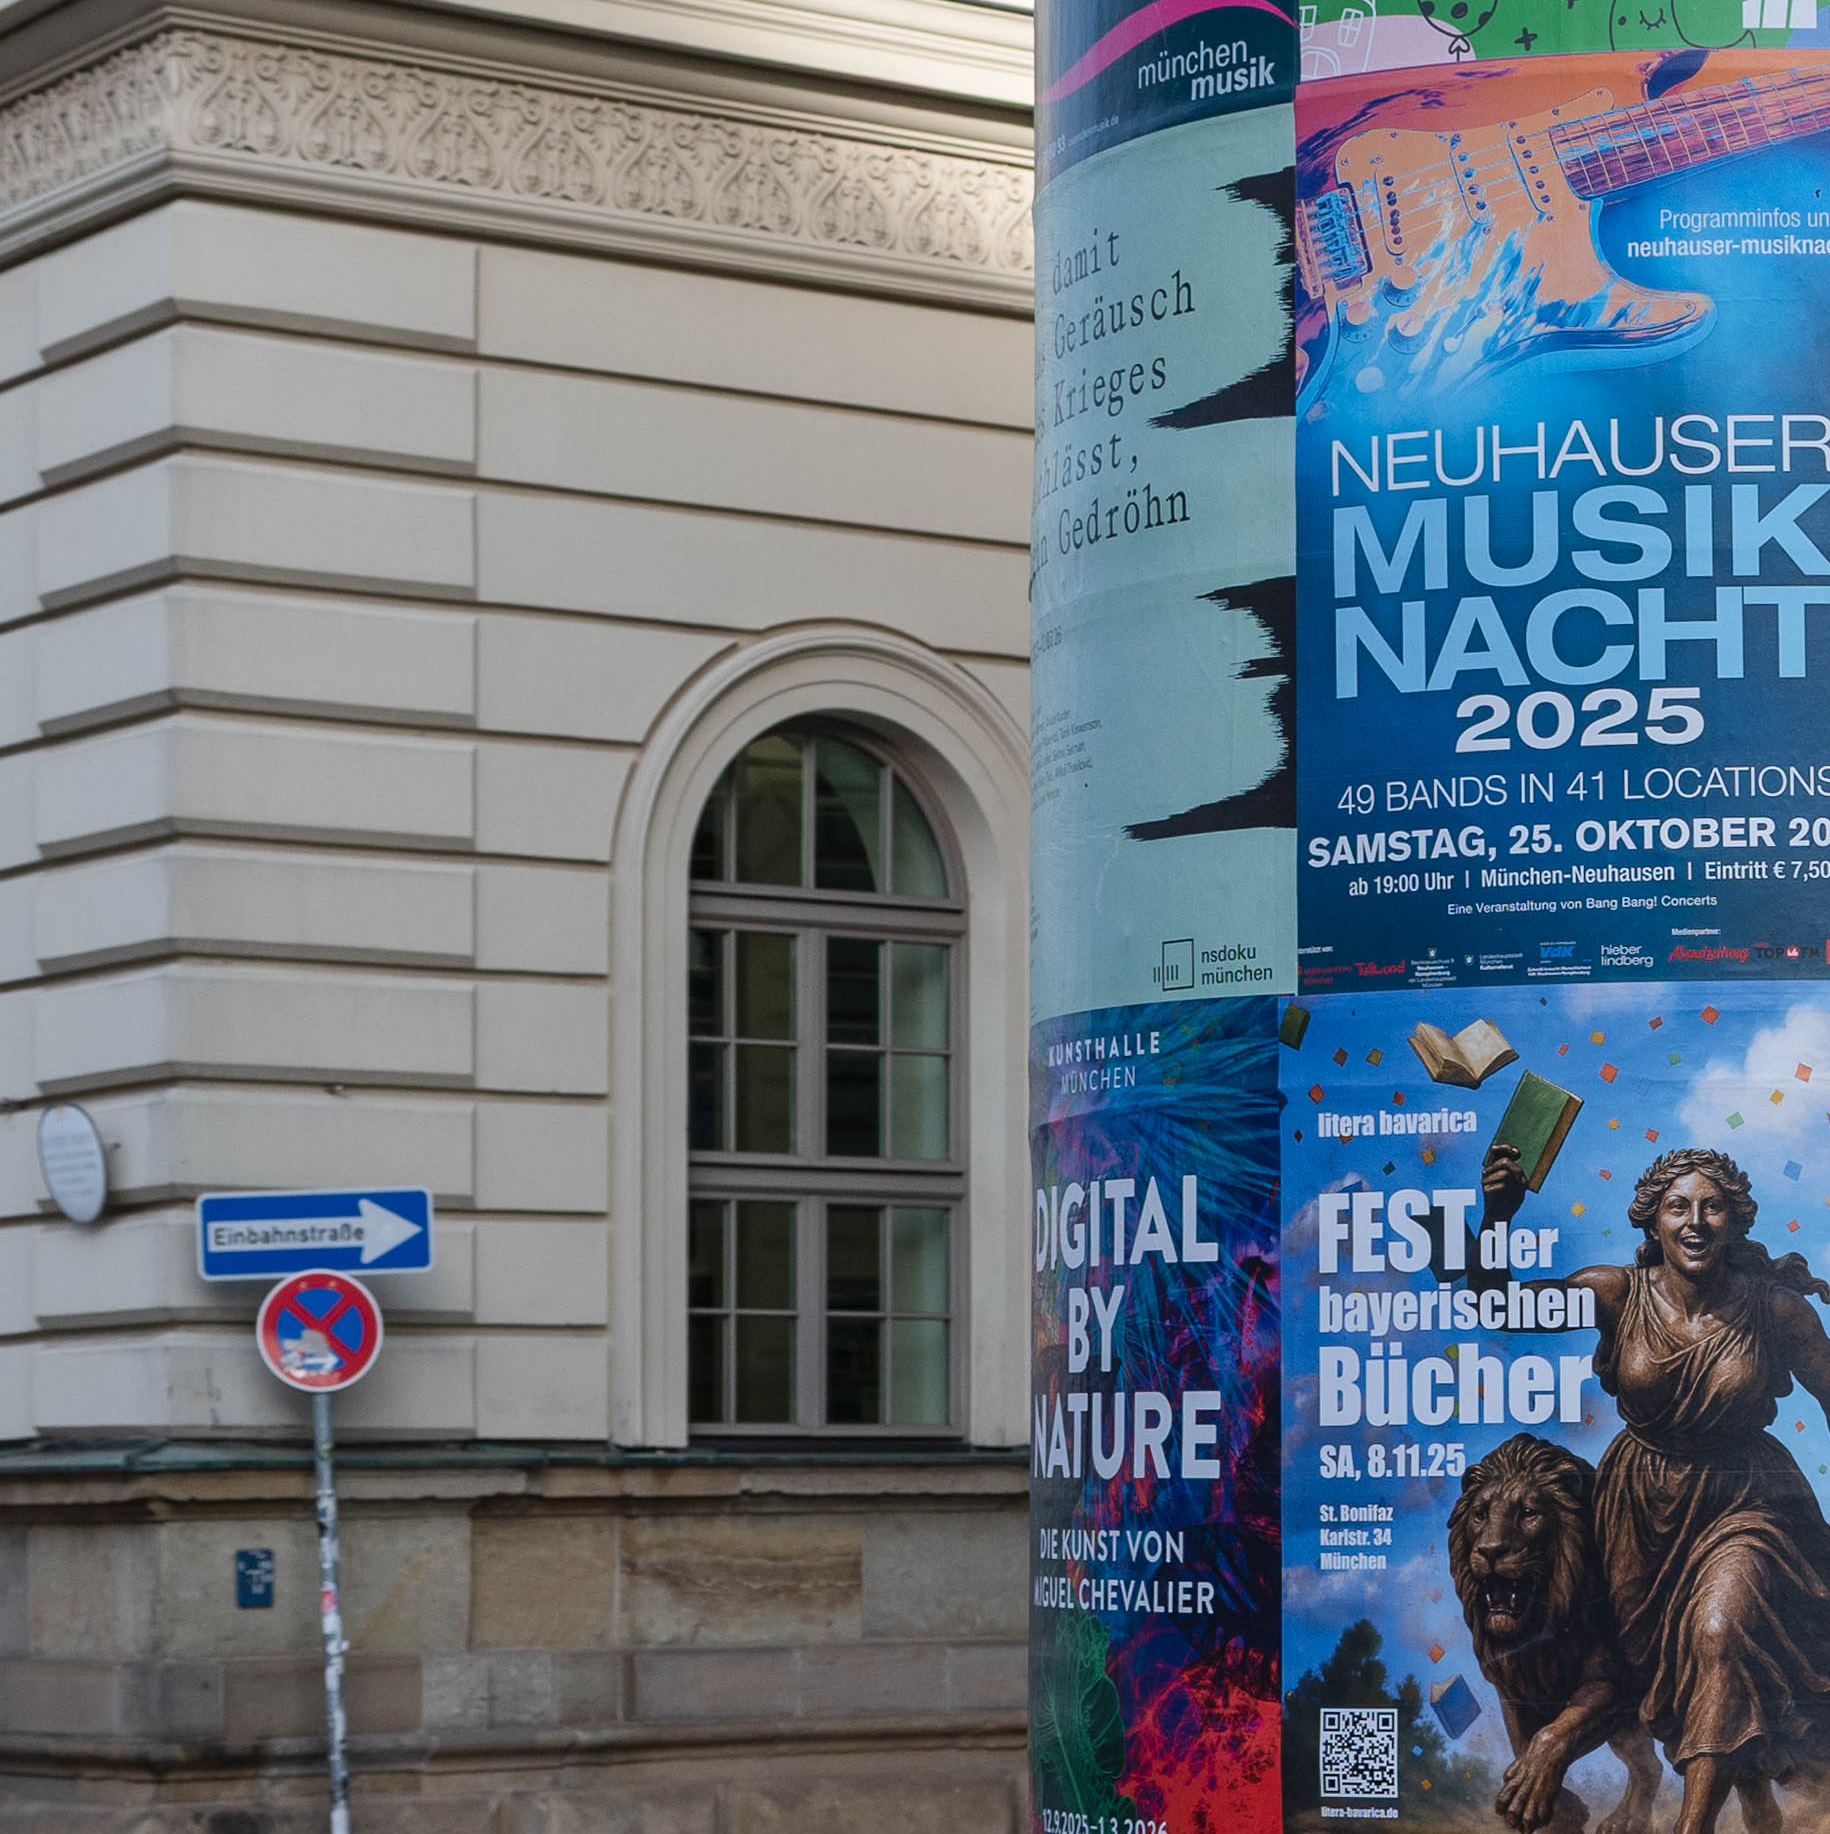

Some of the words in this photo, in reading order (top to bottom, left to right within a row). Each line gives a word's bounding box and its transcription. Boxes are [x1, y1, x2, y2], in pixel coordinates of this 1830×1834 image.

[1138, 40, 1247, 89] münchen
[1191, 56, 1275, 101] musik
[1660, 209, 1801, 233] Programminfos
[1052, 227, 1120, 295] damit
[1053, 270, 1195, 360] Geräusch
[1053, 356, 1167, 428] Krieges
[1059, 483, 1191, 556] Gedröhn
[1455, 687, 1704, 753] 2025
[1308, 825, 1497, 868] SAMSTAG,
[1509, 824, 1563, 854] 25.
[1576, 817, 1776, 851] OKTOBER
[1447, 903, 1473, 915] Eine
[1476, 899, 1557, 914] Veranstaltung
[1560, 901, 1582, 910] von
[1586, 897, 1617, 910] Bang
[1622, 895, 1657, 910] Bang!
[1661, 895, 1717, 907] Concerts
[1201, 943, 1257, 963] nsdoku
[1201, 964, 1273, 986] münchen
[1050, 1032, 1160, 1066] KUNSTHALLE
[1061, 1066, 1136, 1094] MÜNCHEN
[1318, 1113, 1375, 1137] litera
[1379, 1109, 1477, 1136] bavarica
[213, 1222, 365, 1247] Einbahnstraße
[1036, 1175, 1219, 1272] DIGITAL
[1318, 1188, 1477, 1274] FEST
[1480, 1222, 1559, 1269] der
[1069, 1286, 1125, 1373] BY
[1319, 1281, 1596, 1336] bayerischen
[1319, 1343, 1594, 1426] Bücher
[1034, 1390, 1221, 1480] NATURE
[1320, 1445, 1362, 1482] SA,
[1368, 1444, 1466, 1477] 8.11.25
[1040, 1528, 1058, 1560] DIE
[1062, 1529, 1120, 1562] KUNST
[1126, 1531, 1184, 1563] VON
[1078, 1578, 1215, 1614] CHEVALIER
